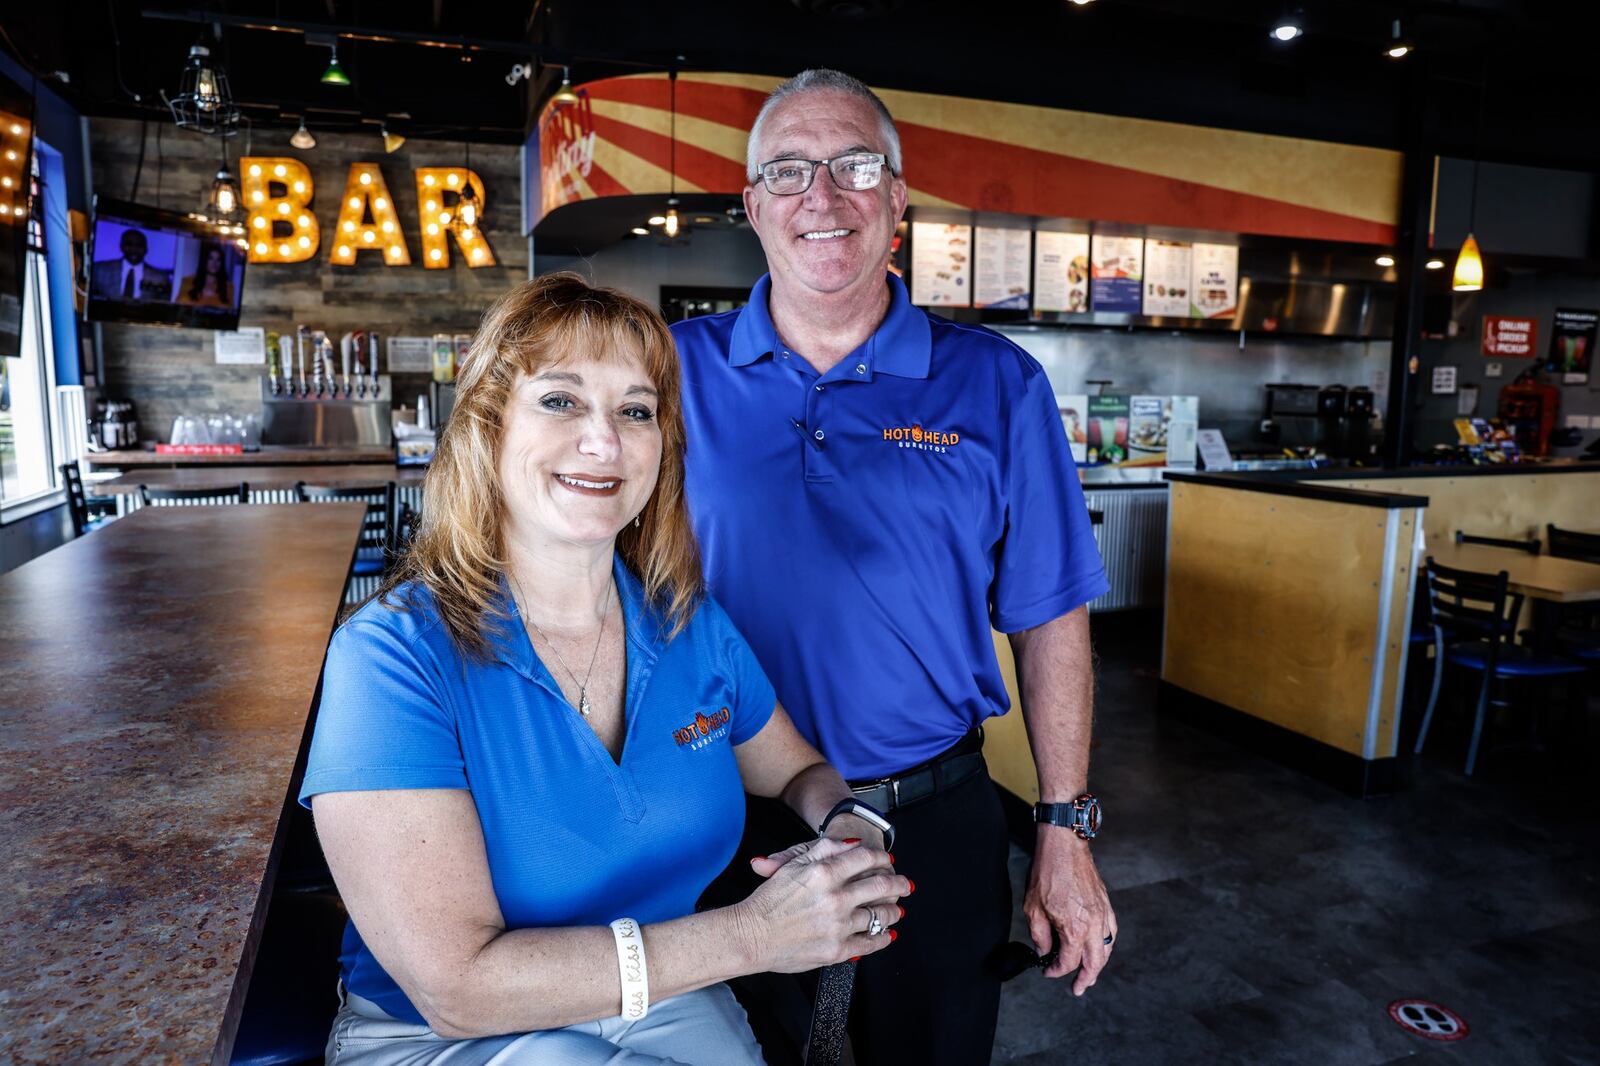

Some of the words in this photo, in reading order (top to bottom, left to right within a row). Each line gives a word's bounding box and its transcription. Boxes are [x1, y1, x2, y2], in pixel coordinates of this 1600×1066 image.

[240, 157, 496, 269] BAR
[1497, 319, 1531, 331] ONLINE
[1496, 331, 1528, 343] ORDER
[1496, 342, 1530, 354] PICKUP
[883, 427, 911, 441] HOT
[923, 431, 960, 446] HEAD
[898, 441, 946, 454] BURRITOS
[672, 723, 699, 747] HOT
[626, 944, 642, 983] Kiss
